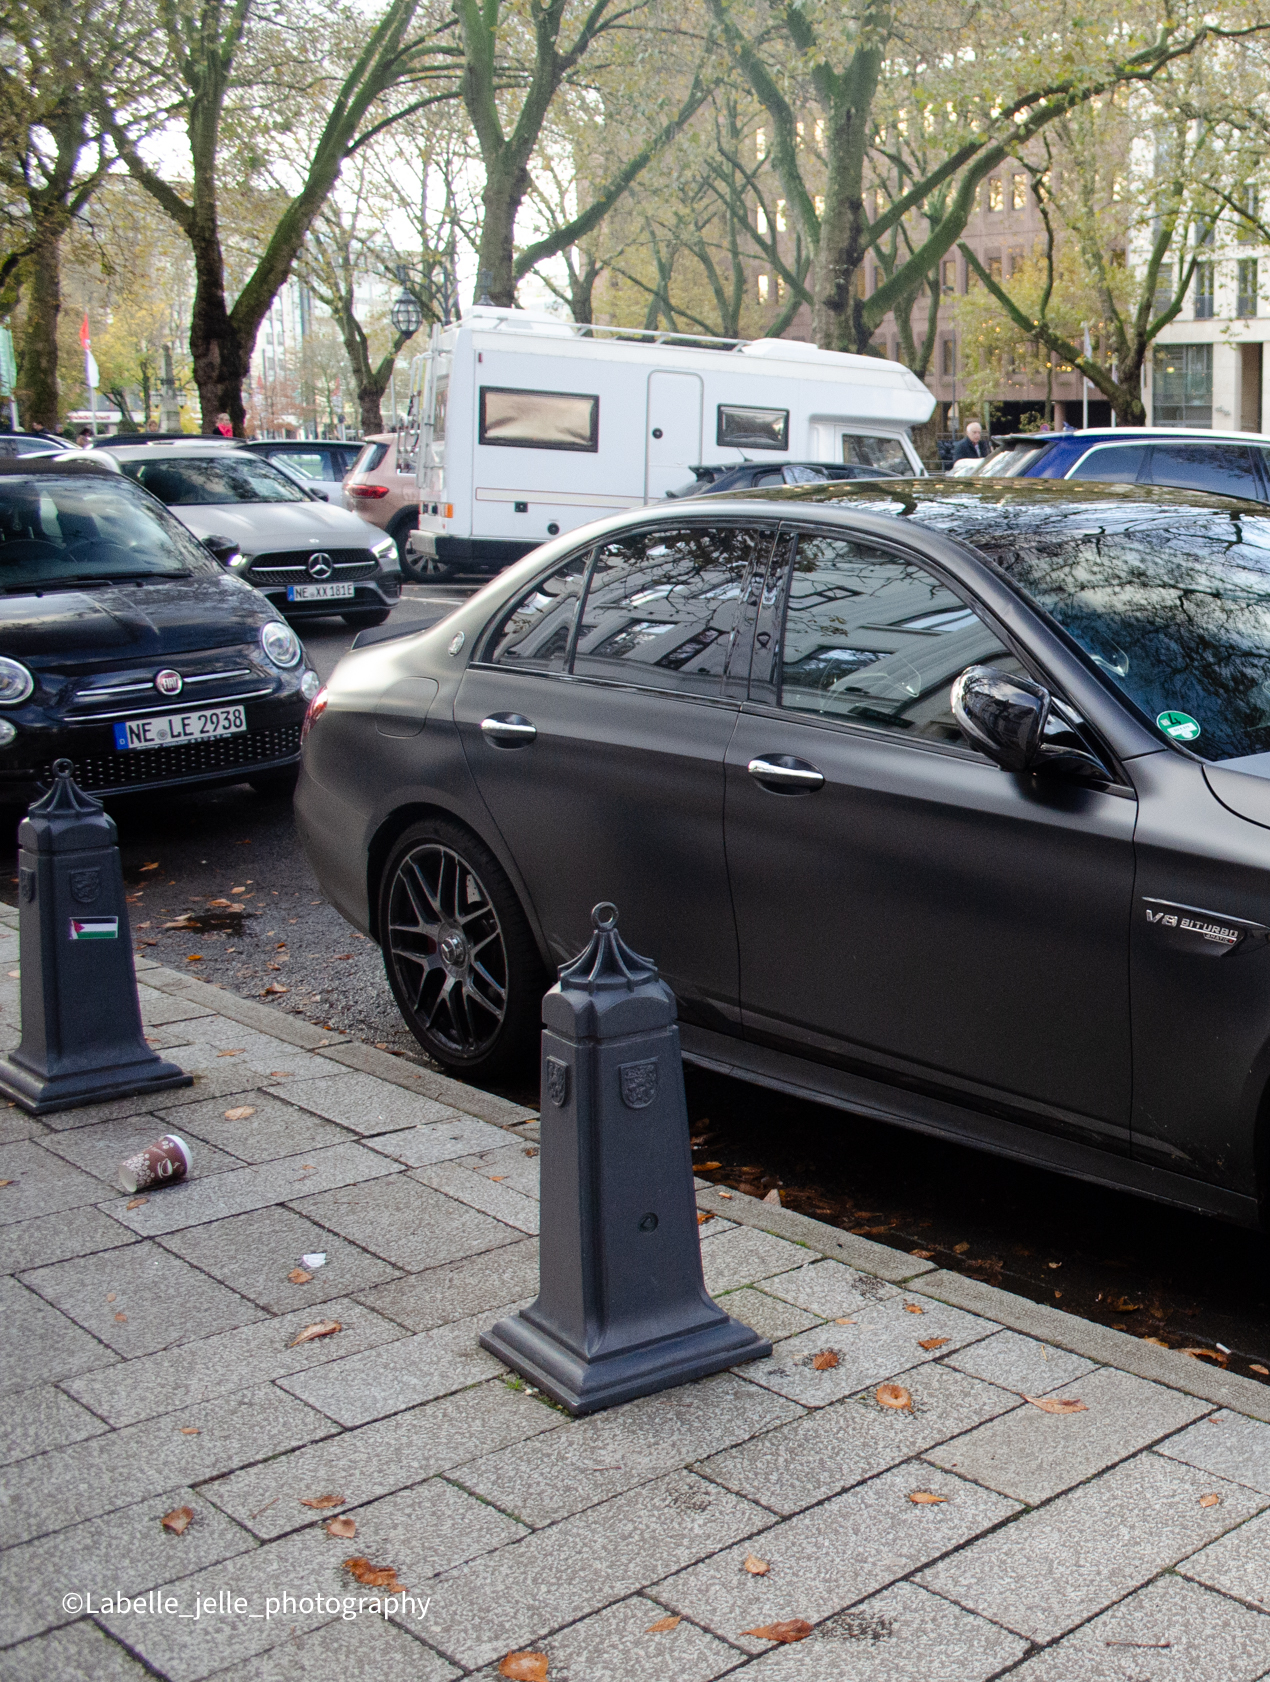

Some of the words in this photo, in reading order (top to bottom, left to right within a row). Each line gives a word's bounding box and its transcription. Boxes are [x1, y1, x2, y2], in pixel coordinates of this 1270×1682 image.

[295, 587, 308, 599] NE
[162, 677, 178, 689] FIAT
[128, 722, 155, 744] NE
[168, 716, 194, 738] LE
[198, 709, 244, 734] 2938
[1145, 909, 1179, 928] V8
